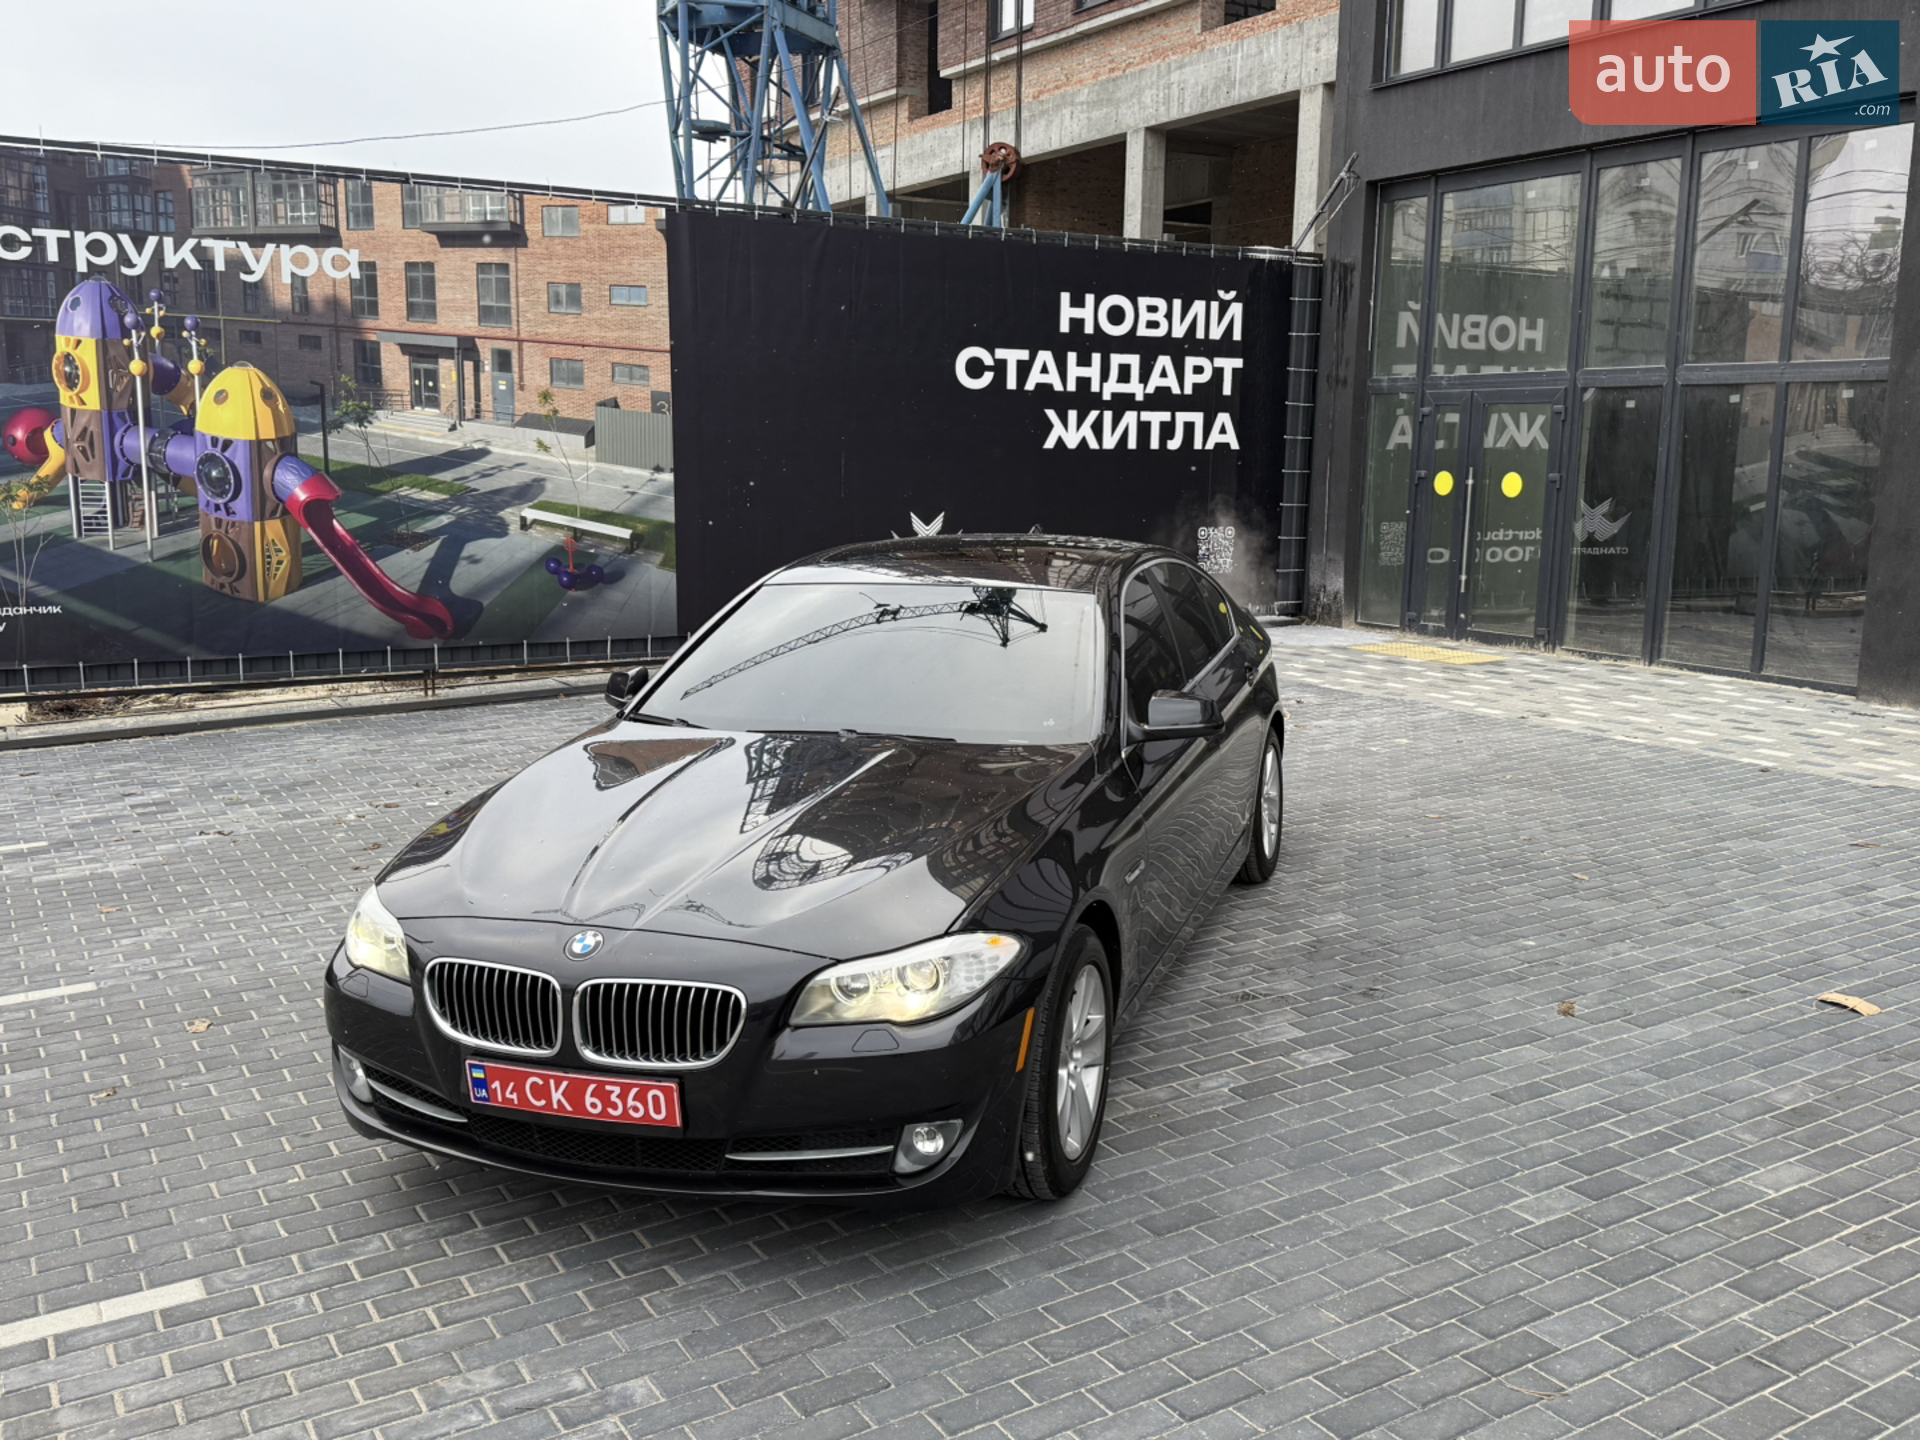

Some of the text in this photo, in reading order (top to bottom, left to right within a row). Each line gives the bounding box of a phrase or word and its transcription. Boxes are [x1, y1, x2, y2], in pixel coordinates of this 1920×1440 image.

[0, 225, 361, 283] структура
[1059, 289, 1243, 341] НОВИЙ
[955, 346, 1244, 401] СТАНДАРТ
[1042, 408, 1240, 451] ЖИТЛА
[474, 1076, 667, 1121] UA 14 CK 6360
